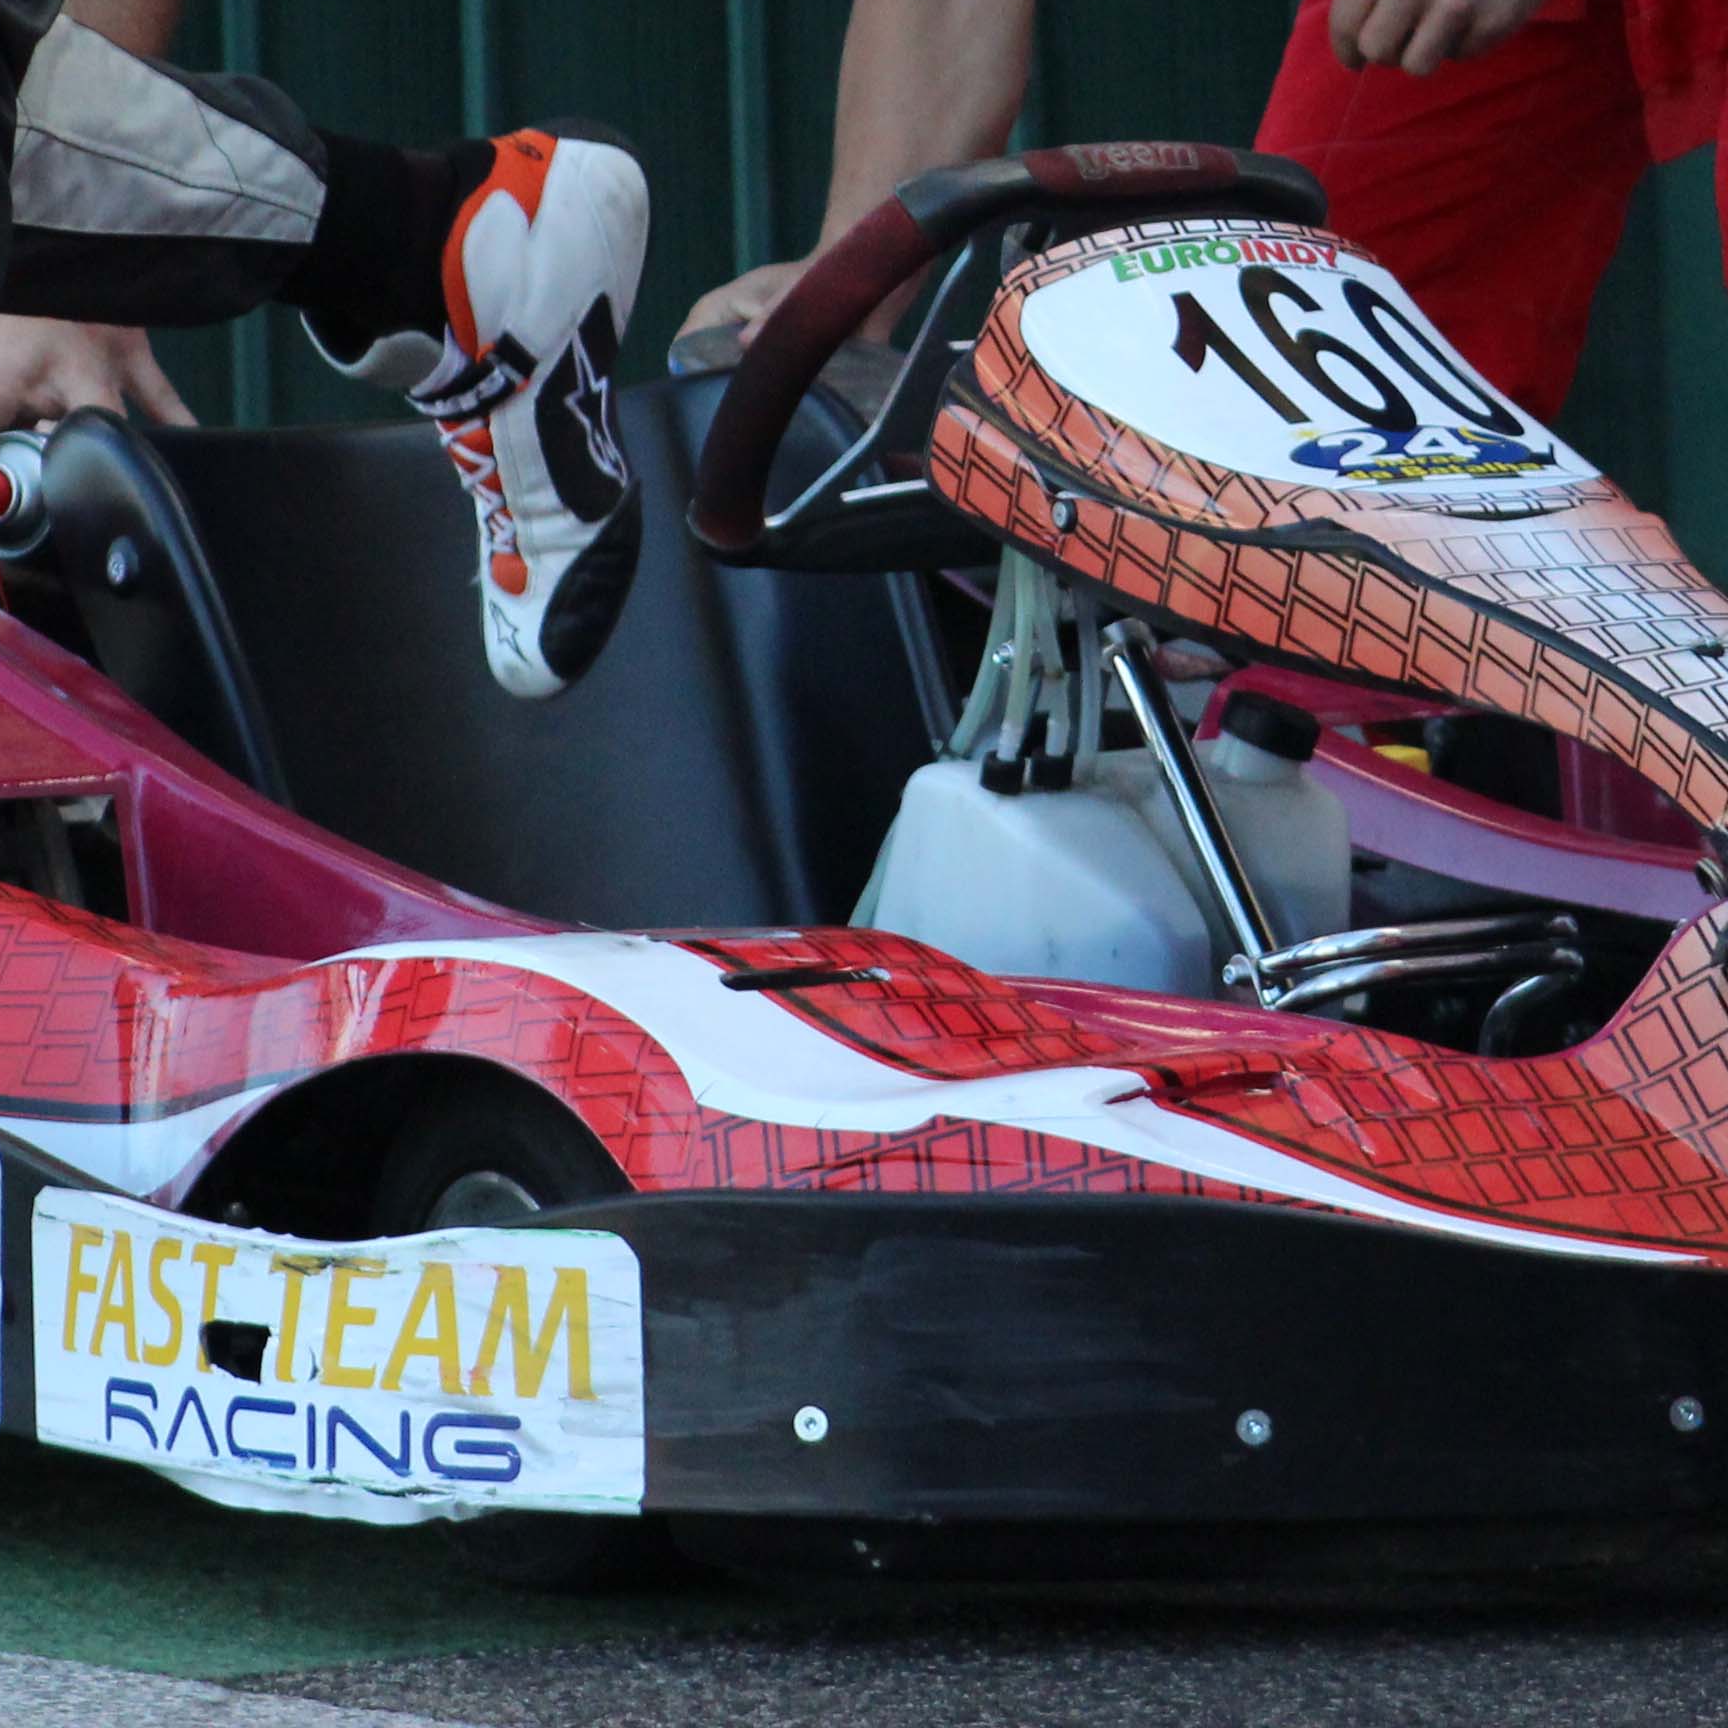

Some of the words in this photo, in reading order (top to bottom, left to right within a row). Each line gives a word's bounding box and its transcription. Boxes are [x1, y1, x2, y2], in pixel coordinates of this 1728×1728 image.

[1110, 238, 1339, 283] EUROINDY
[1171, 263, 1526, 437] 160
[1316, 427, 1481, 467] 24
[62, 1223, 236, 1374] FAST
[270, 1252, 599, 1401] TEAM
[105, 1377, 522, 1483] RACING
